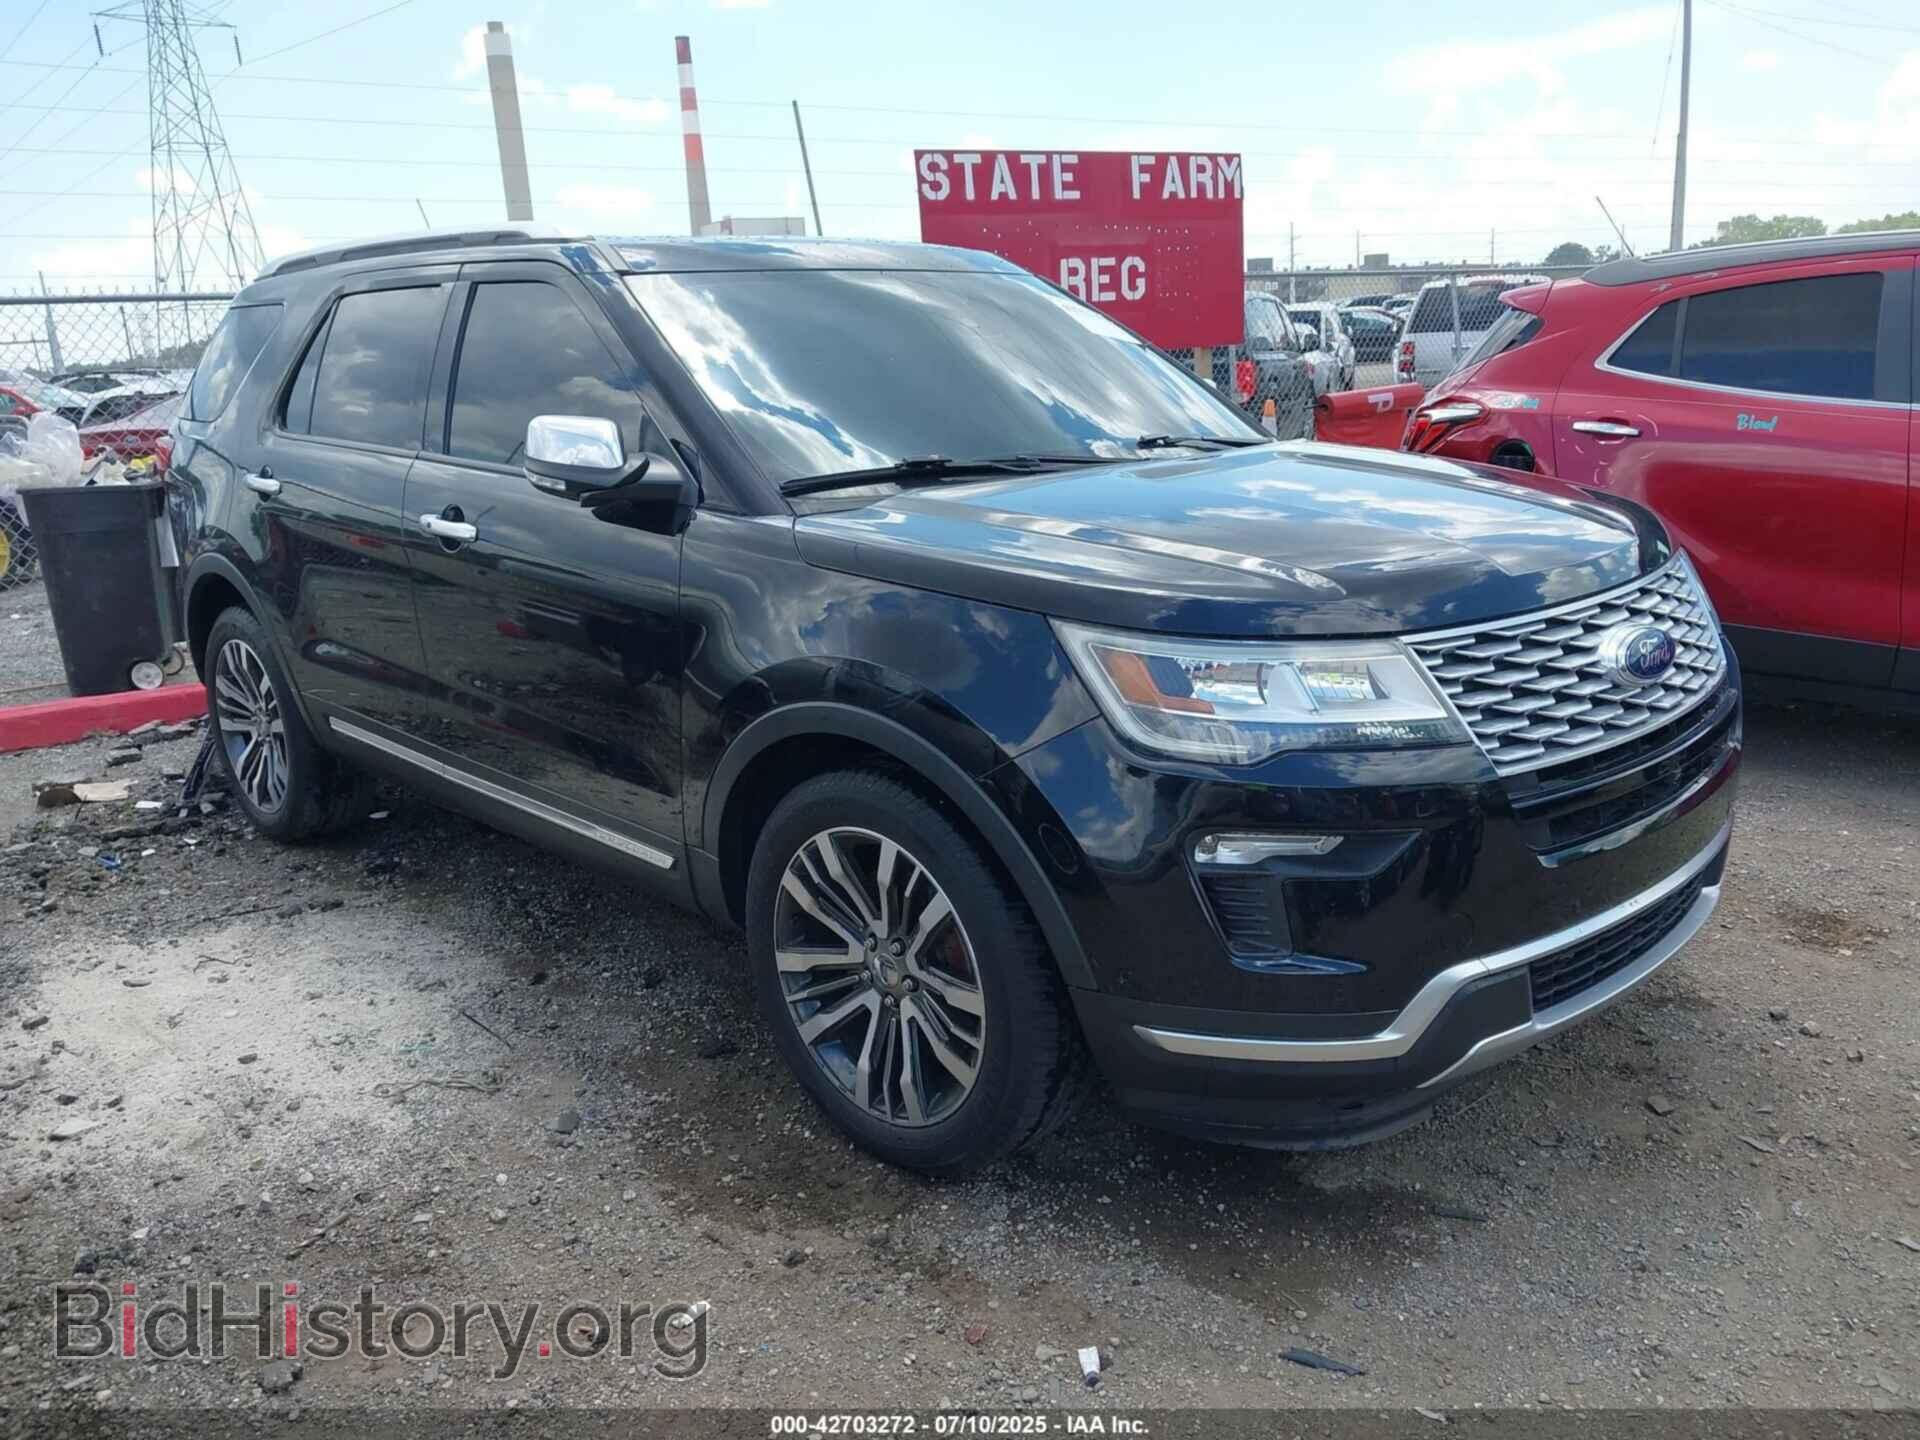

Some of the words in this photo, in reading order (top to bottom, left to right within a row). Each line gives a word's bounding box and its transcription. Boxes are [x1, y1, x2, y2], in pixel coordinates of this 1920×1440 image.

[919, 153, 1080, 200] STATE
[1131, 155, 1241, 199] FARM
[1060, 256, 1146, 302] REG
[1639, 637, 1671, 669] Ford
